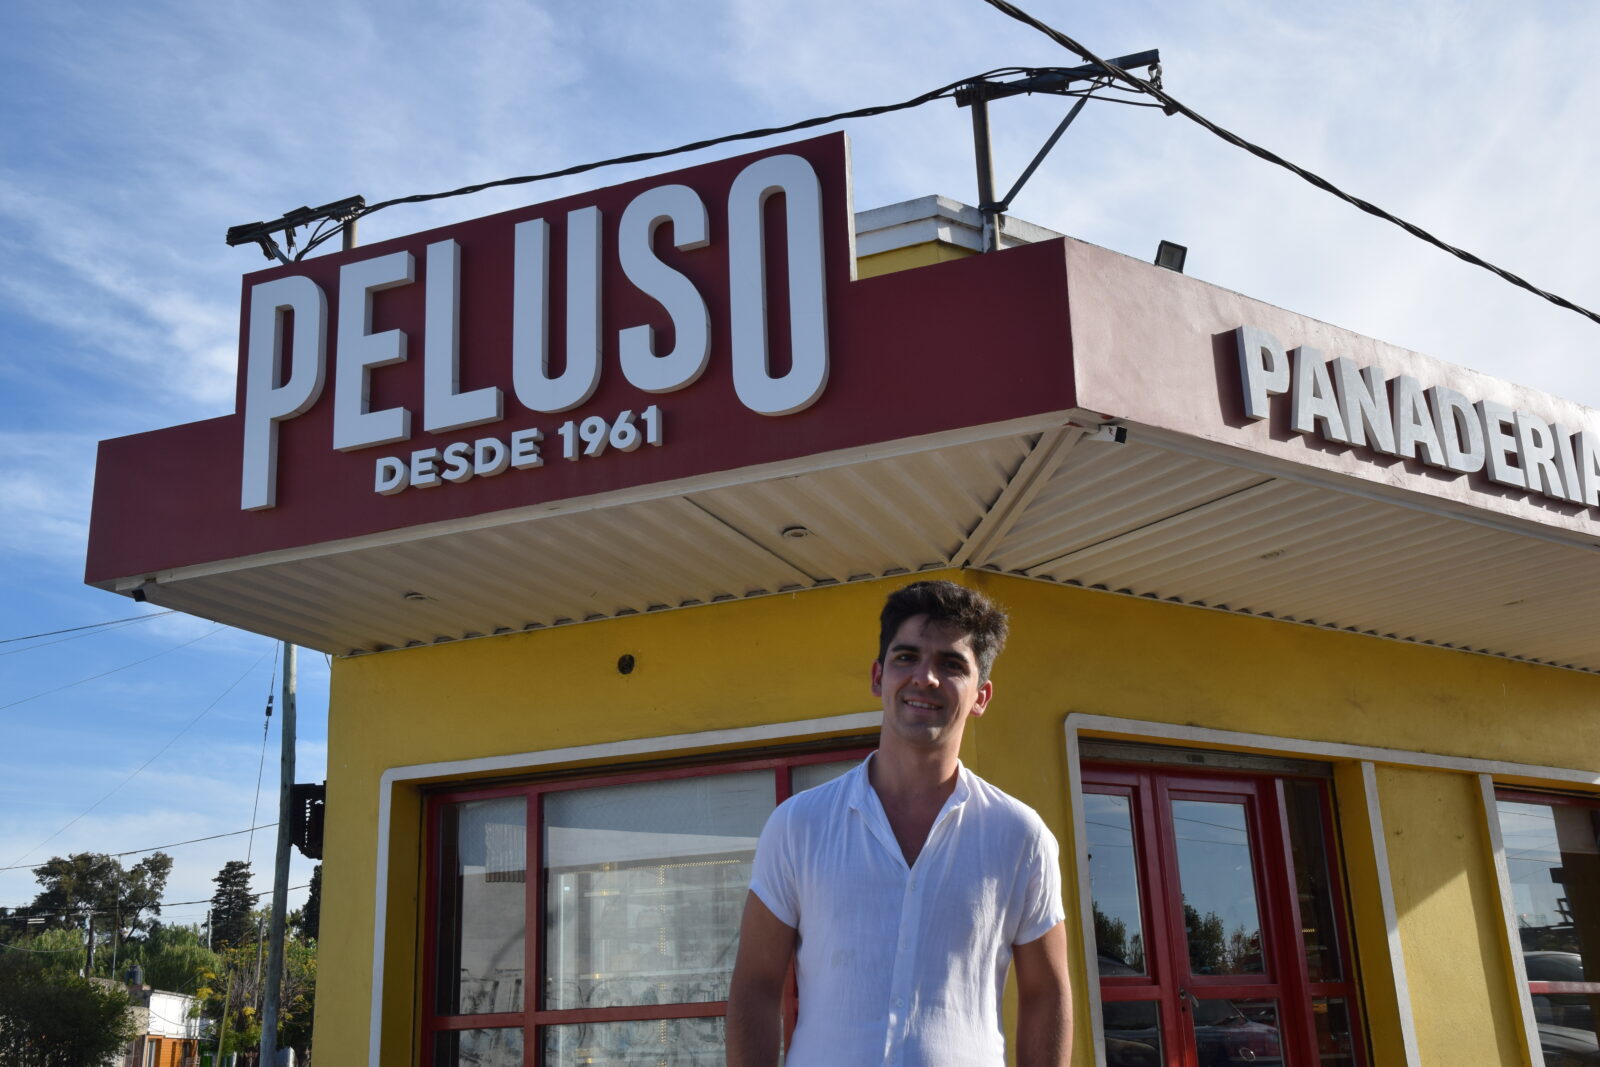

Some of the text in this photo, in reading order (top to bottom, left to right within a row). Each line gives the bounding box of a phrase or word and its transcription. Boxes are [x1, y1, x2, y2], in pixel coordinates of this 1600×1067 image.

[241, 154, 829, 511] PELUSO
[375, 405, 662, 496] DESDE 1961
